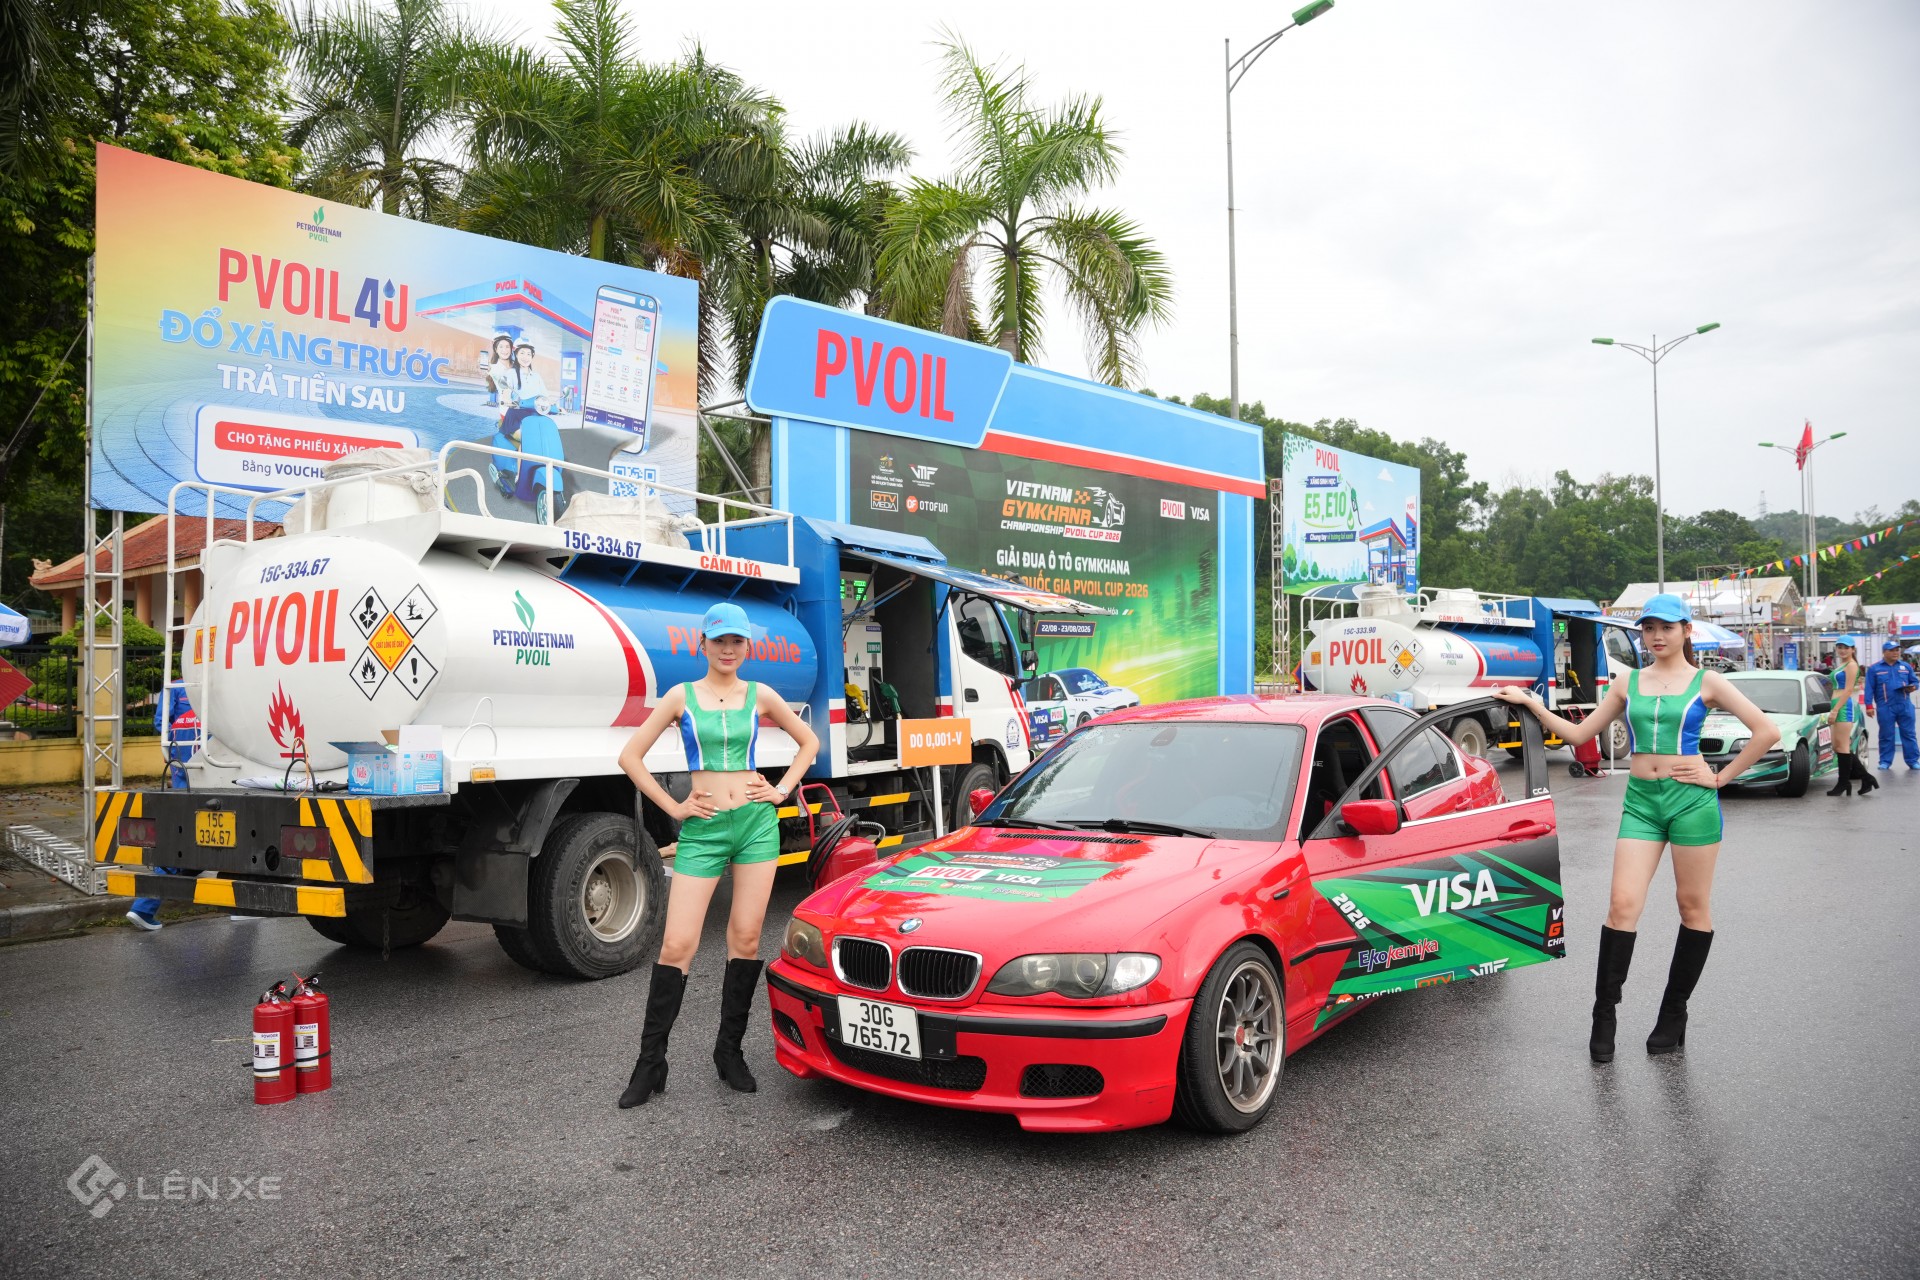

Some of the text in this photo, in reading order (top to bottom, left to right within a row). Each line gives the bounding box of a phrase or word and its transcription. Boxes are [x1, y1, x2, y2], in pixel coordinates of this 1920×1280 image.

[296, 221, 342, 238] PETROVIETNAM
[309, 232, 329, 243] PVOIL
[495, 279, 518, 293] PVOIL
[159, 306, 450, 385] ĐỔ XĂNG TRƯỚC
[813, 328, 955, 423] PVOIL
[216, 363, 406, 414] TRẢ TIỀN SAU
[227, 431, 255, 444] CHO
[257, 433, 292, 450] TẶNG
[294, 434, 331, 453] PHIẾU
[242, 460, 272, 476] Bằng
[1316, 448, 1341, 473] PVOIL
[1006, 479, 1073, 504] VIETNAM
[1002, 498, 1092, 526] GYMKHANA
[1162, 501, 1210, 521] PVOIL VISA
[1000, 519, 1120, 541] CHAMPIONSHIP PVOIL CUP 2026
[563, 530, 642, 559] 15C-334.67
[260, 557, 331, 584] 15C-334.67
[700, 554, 763, 578] CẤM LỬA
[996, 544, 1130, 576] GIẢI ĐUA Ô TÔ GYMKHANA
[1053, 578, 1071, 595] GIA
[1074, 580, 1102, 597] PVOIL
[1104, 581, 1123, 597] CUP
[1125, 583, 1149, 598] 2026
[225, 588, 346, 670] PVOIL
[492, 629, 575, 650] PETROVIETNAM
[1041, 624, 1058, 633] 22/08
[1061, 624, 1091, 634] 23/08/2026
[515, 649, 552, 666] PVOIL
[1329, 637, 1387, 667] PVOIL
[1034, 714, 1049, 725] VISA
[910, 731, 963, 750] DO 0,001-V
[208, 812, 224, 828] 15C
[199, 829, 231, 846] 334.67
[917, 867, 1043, 885] PVOIL VISA
[1401, 868, 1499, 917] VISA
[1331, 892, 1371, 930] 2026
[860, 1002, 894, 1028] 30G
[848, 1022, 912, 1055] 765.72
